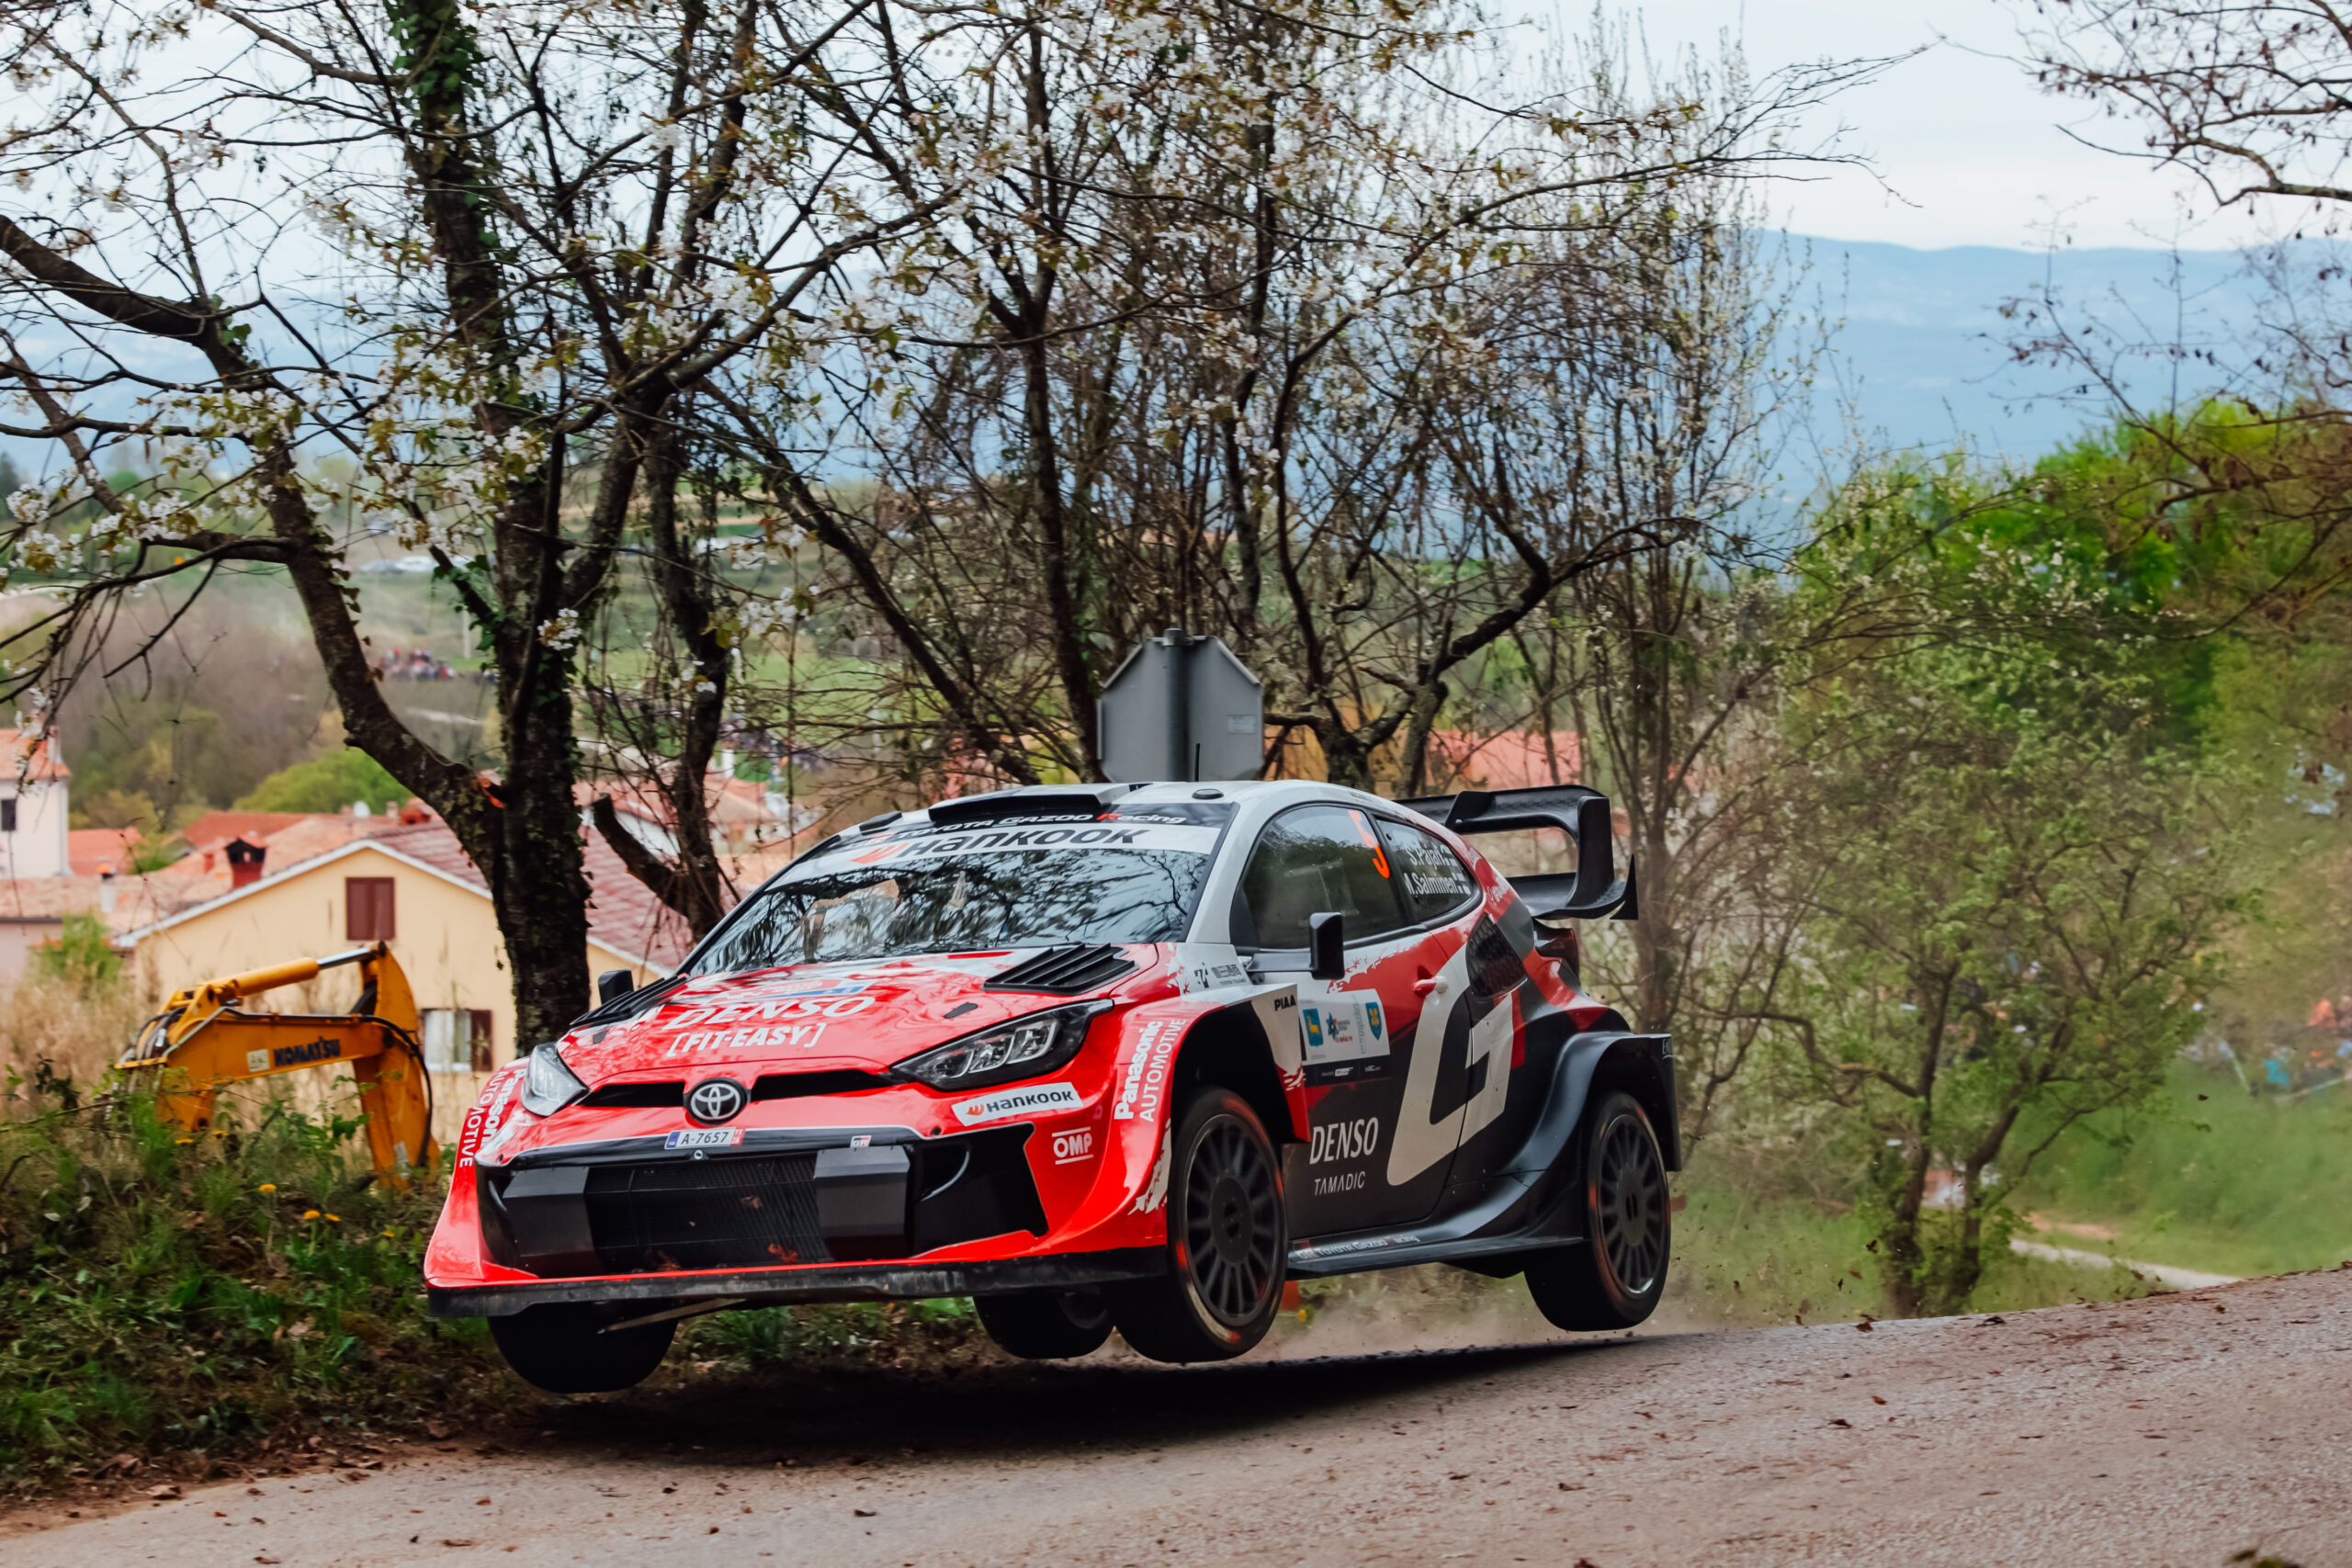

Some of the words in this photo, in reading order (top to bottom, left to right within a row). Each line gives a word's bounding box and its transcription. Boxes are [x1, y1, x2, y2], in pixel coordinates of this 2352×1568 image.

[899, 820, 994, 838] TOYOTA
[1097, 813, 1187, 824] Racing
[662, 997, 876, 1030] DENSO
[1274, 995, 1296, 1010] PIAA
[1114, 1021, 1163, 1120] Panasonic
[1139, 1019, 1187, 1122] AUTOMOTIVE
[681, 1132, 729, 1145] A-7657
[1053, 1132, 1093, 1158] OMP
[1309, 1117, 1378, 1165] DENSO
[1314, 1170, 1365, 1196] TAMADIC
